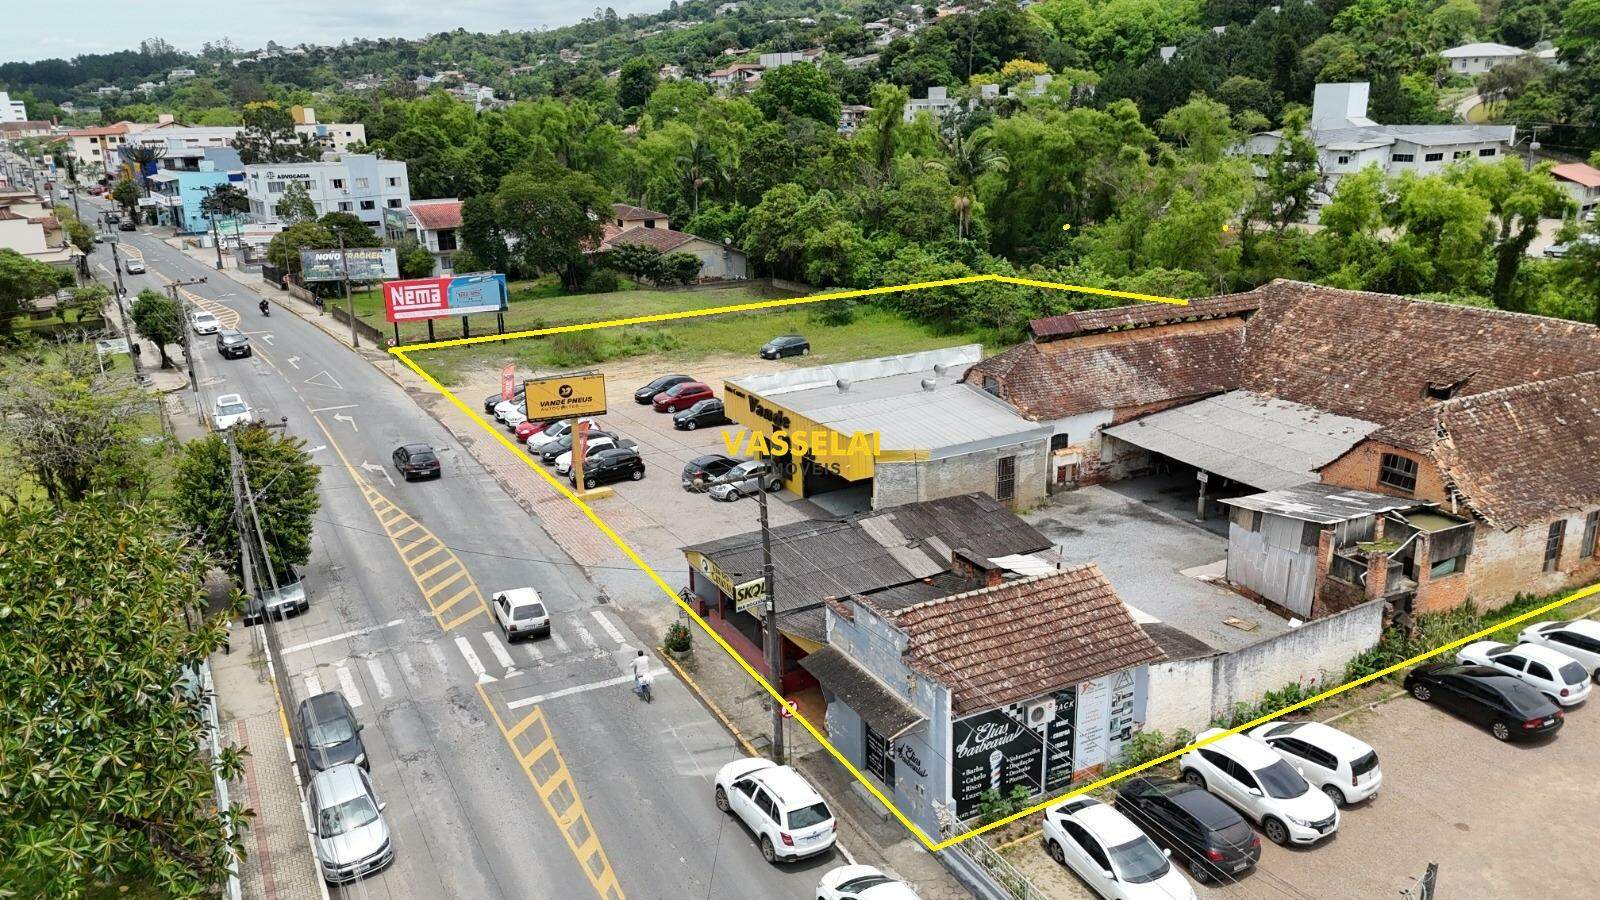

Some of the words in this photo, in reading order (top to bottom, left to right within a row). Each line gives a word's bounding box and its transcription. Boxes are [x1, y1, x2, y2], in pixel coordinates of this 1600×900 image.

[315, 252, 341, 260] NOVO
[390, 286, 441, 306] Nema
[540, 398, 566, 407] VANDE
[567, 396, 592, 405] PNEUS
[747, 394, 791, 429] Vande
[737, 582, 766, 601] SKOL
[975, 722, 1009, 743] Elias
[956, 724, 1026, 758] barbearia
[965, 765, 984, 776] Barba
[965, 773, 987, 784] Cabelo
[965, 783, 982, 793] Risco
